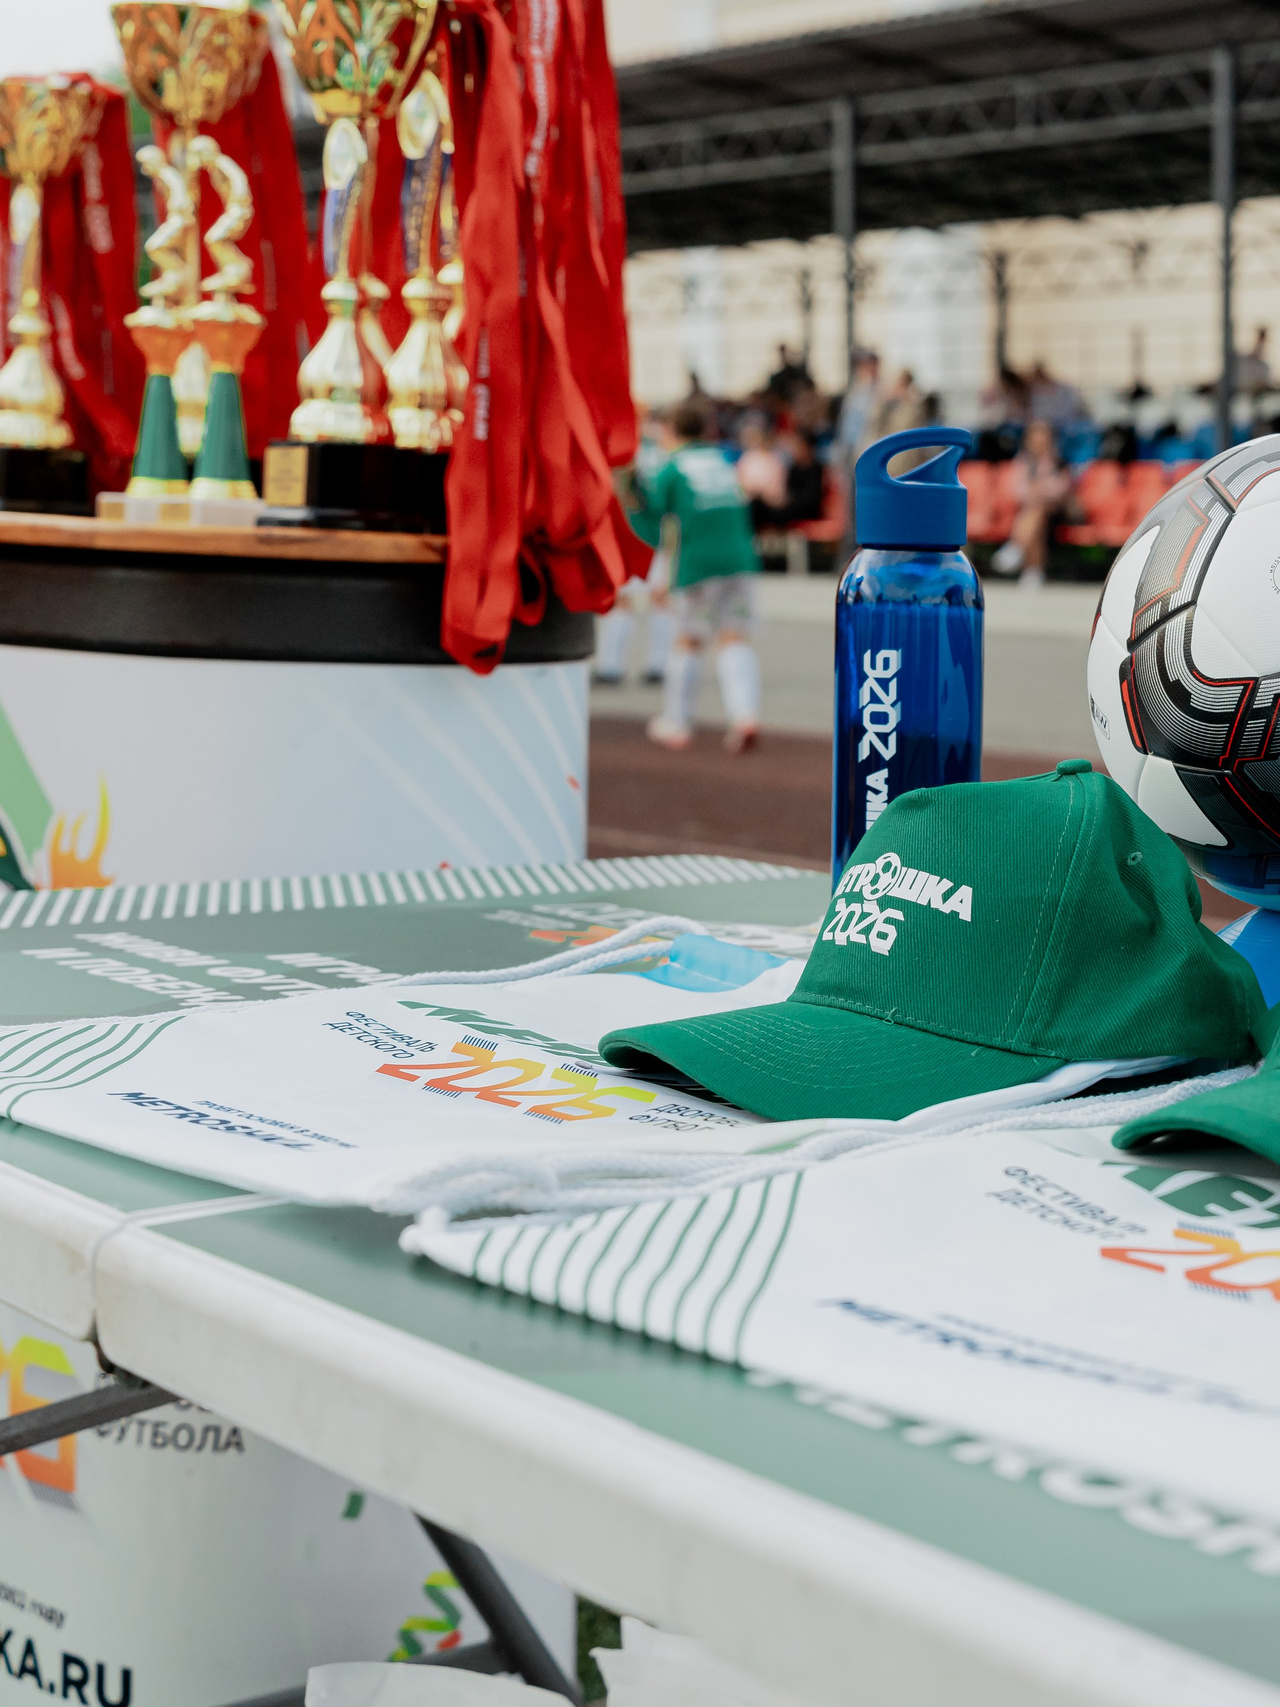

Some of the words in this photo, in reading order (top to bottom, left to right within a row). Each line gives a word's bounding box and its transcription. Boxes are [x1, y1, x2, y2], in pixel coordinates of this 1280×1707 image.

[858, 648, 902, 763] 2026
[822, 897, 905, 957] 2026
[56, 956, 248, 1006] ПОБЕЖ
[321, 1020, 415, 1060] ДЕТСКОГО
[345, 1010, 440, 1055] ФЕСТИВАЛЬ
[374, 1036, 658, 1123] 2026
